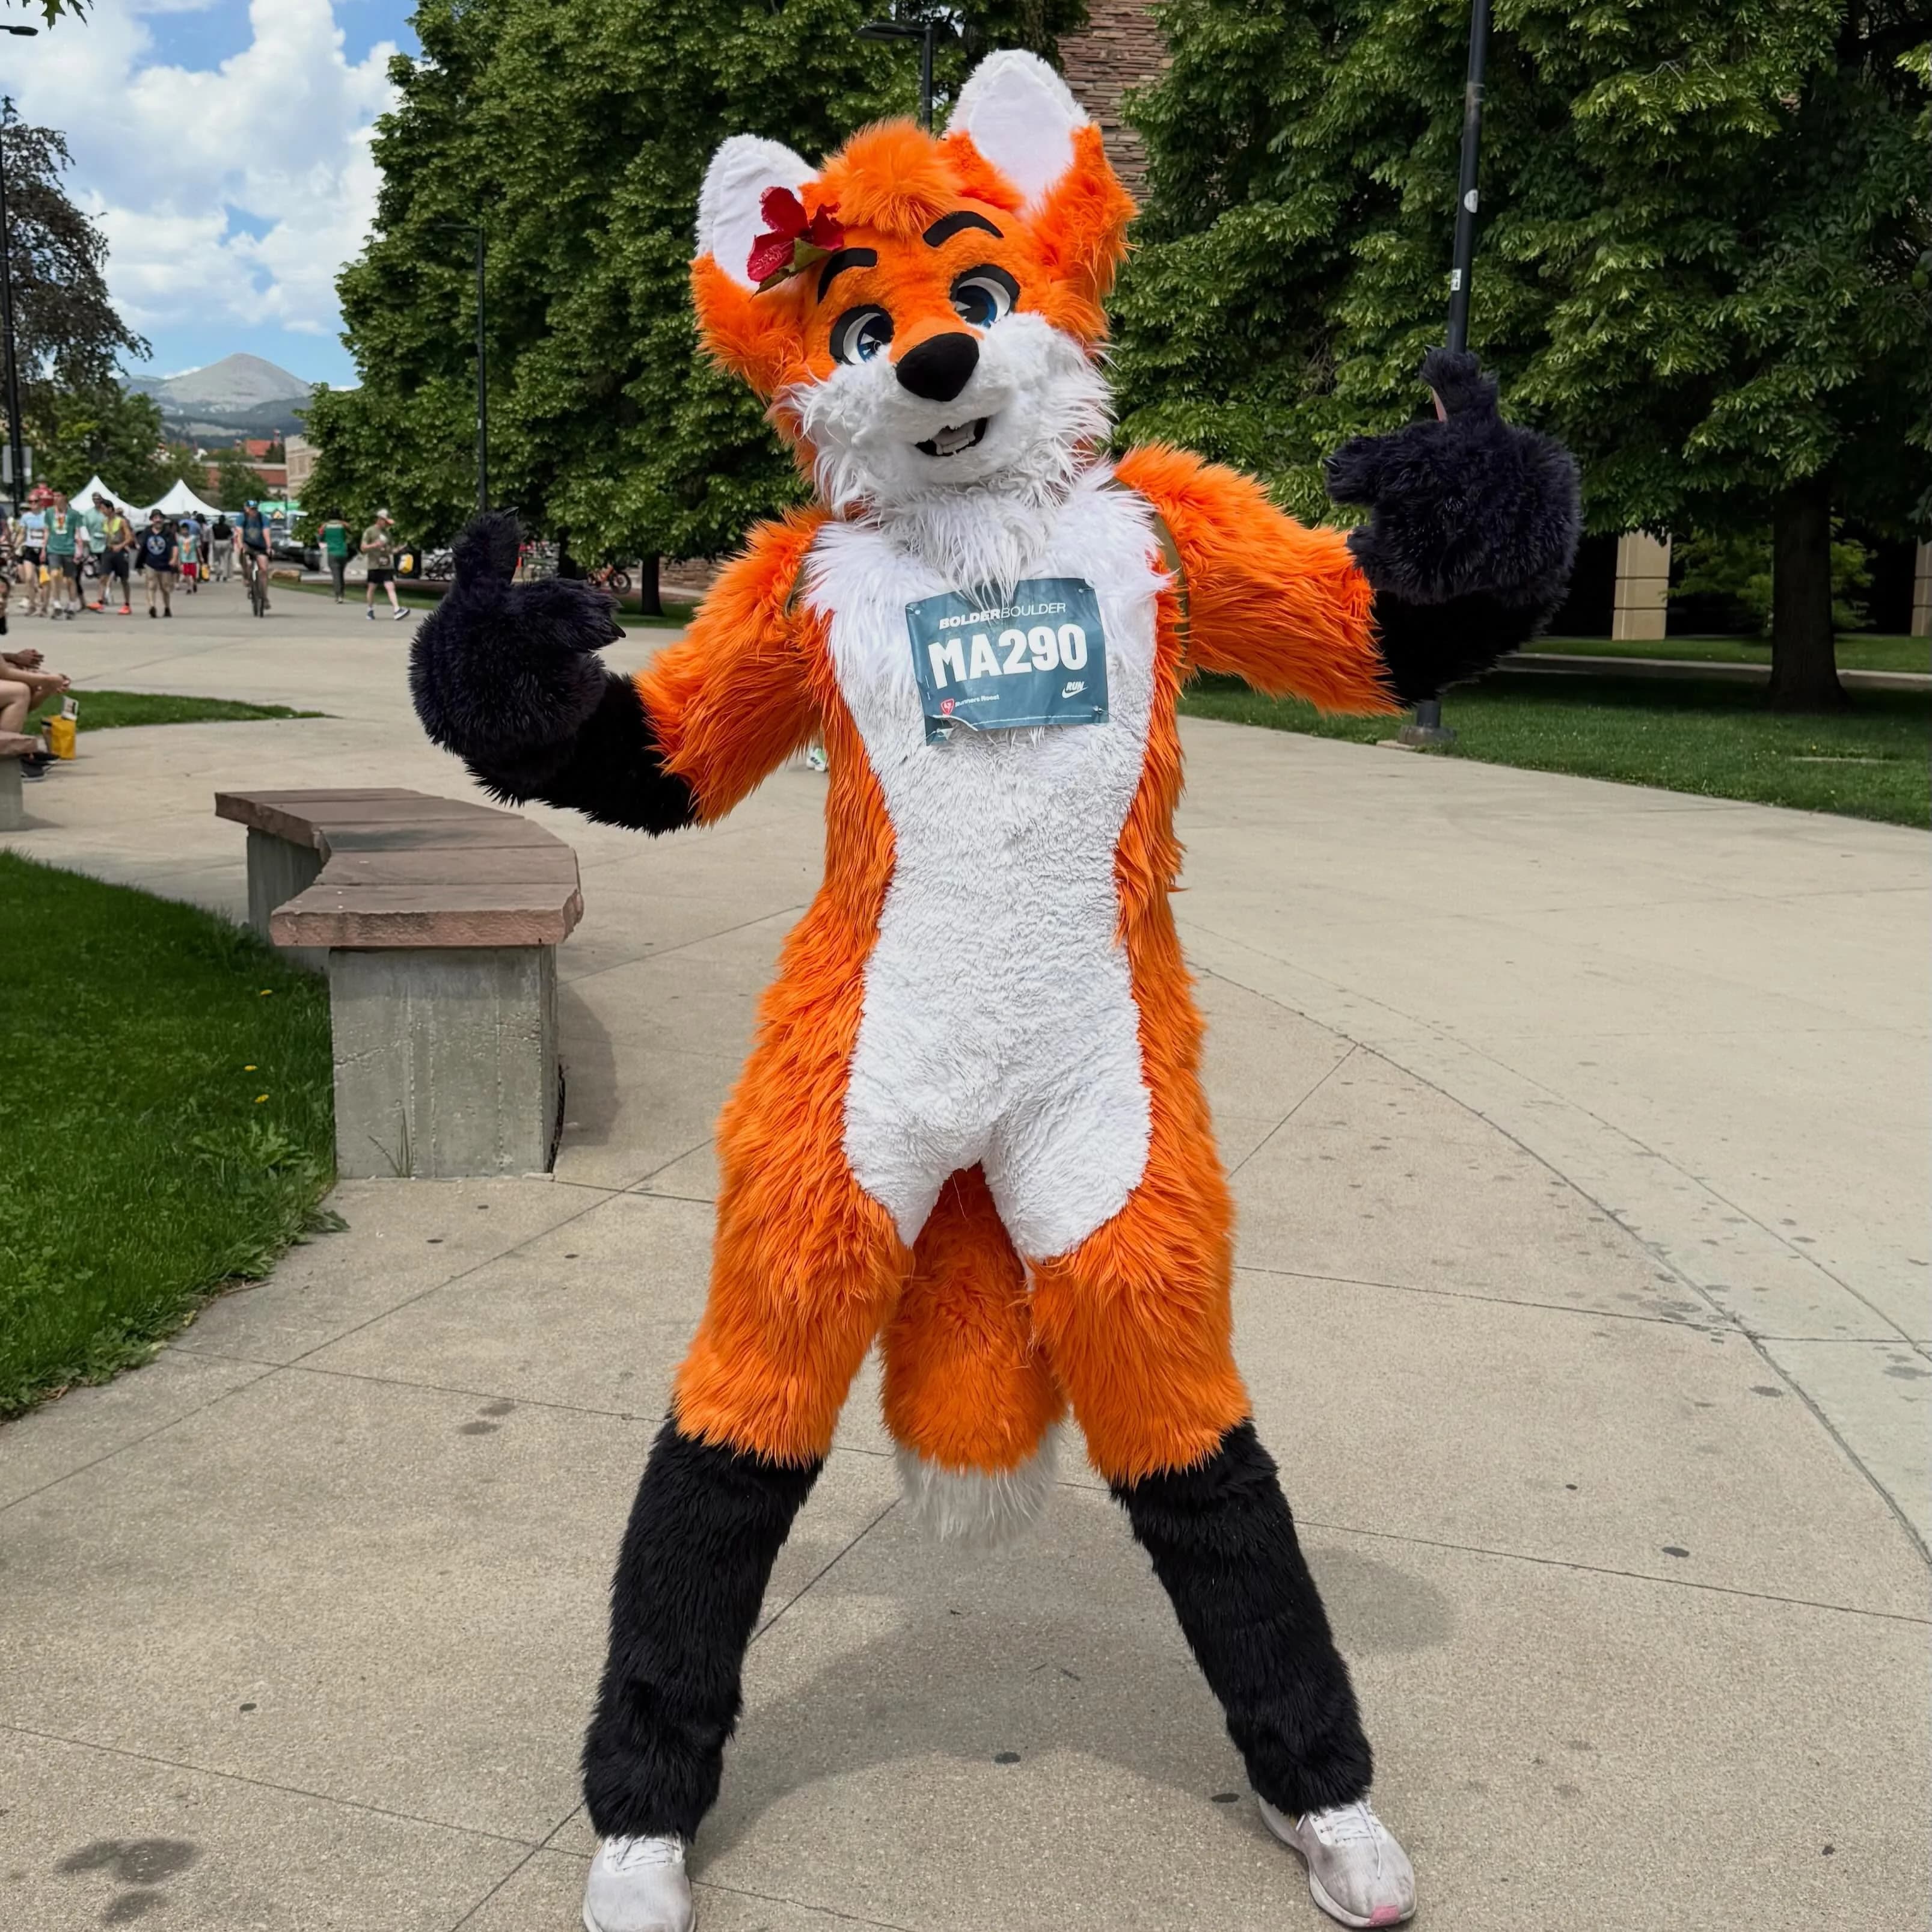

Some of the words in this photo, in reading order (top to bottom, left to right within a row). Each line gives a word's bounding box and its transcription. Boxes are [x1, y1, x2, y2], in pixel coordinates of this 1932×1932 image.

[939, 603, 1066, 630] BOLDERBOULDER
[928, 624, 1088, 689] MA290
[1066, 681, 1085, 692] RUN
